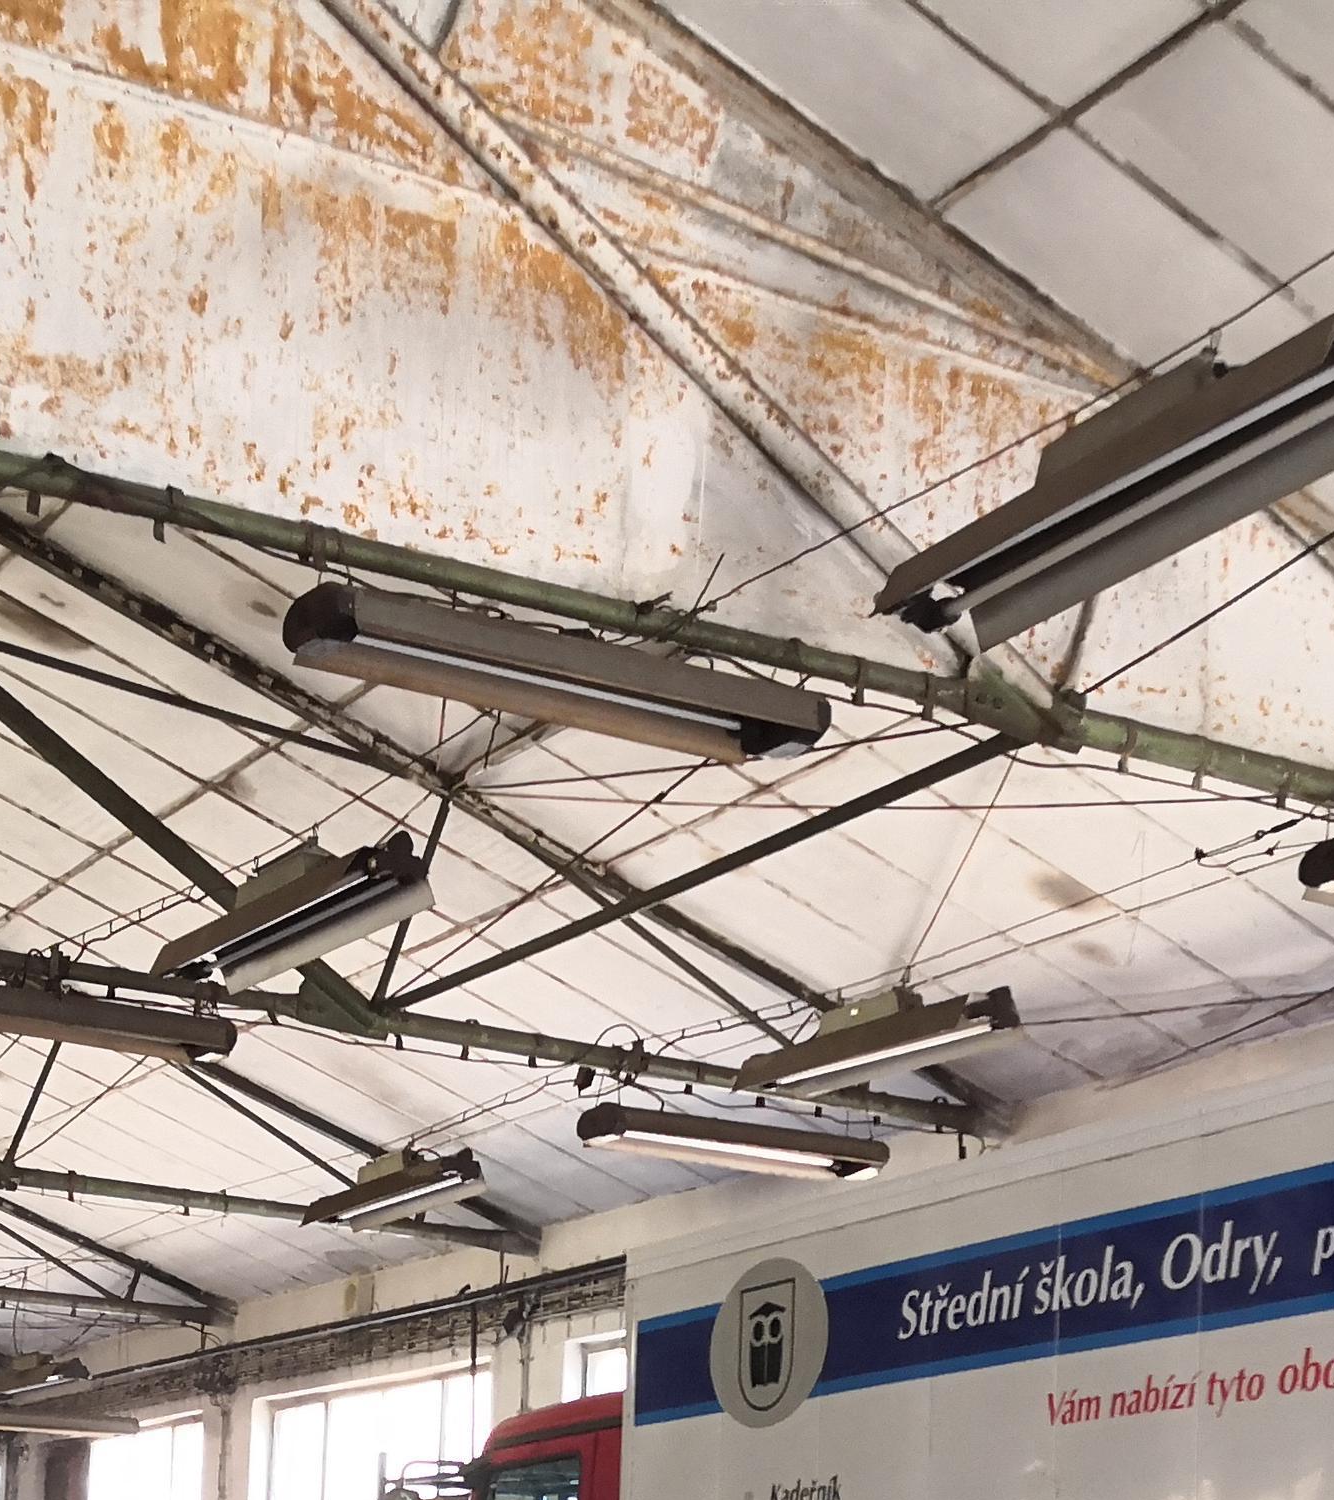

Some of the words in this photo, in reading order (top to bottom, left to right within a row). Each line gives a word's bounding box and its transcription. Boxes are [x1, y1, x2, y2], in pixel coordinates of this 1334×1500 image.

[897, 1264, 1030, 1340] Střední
[1034, 1245, 1145, 1315] škola,
[1161, 1220, 1283, 1295] Odry,
[1046, 1377, 1101, 1427] Vám
[1109, 1371, 1201, 1420] nabízí
[1207, 1367, 1266, 1418] tyto
